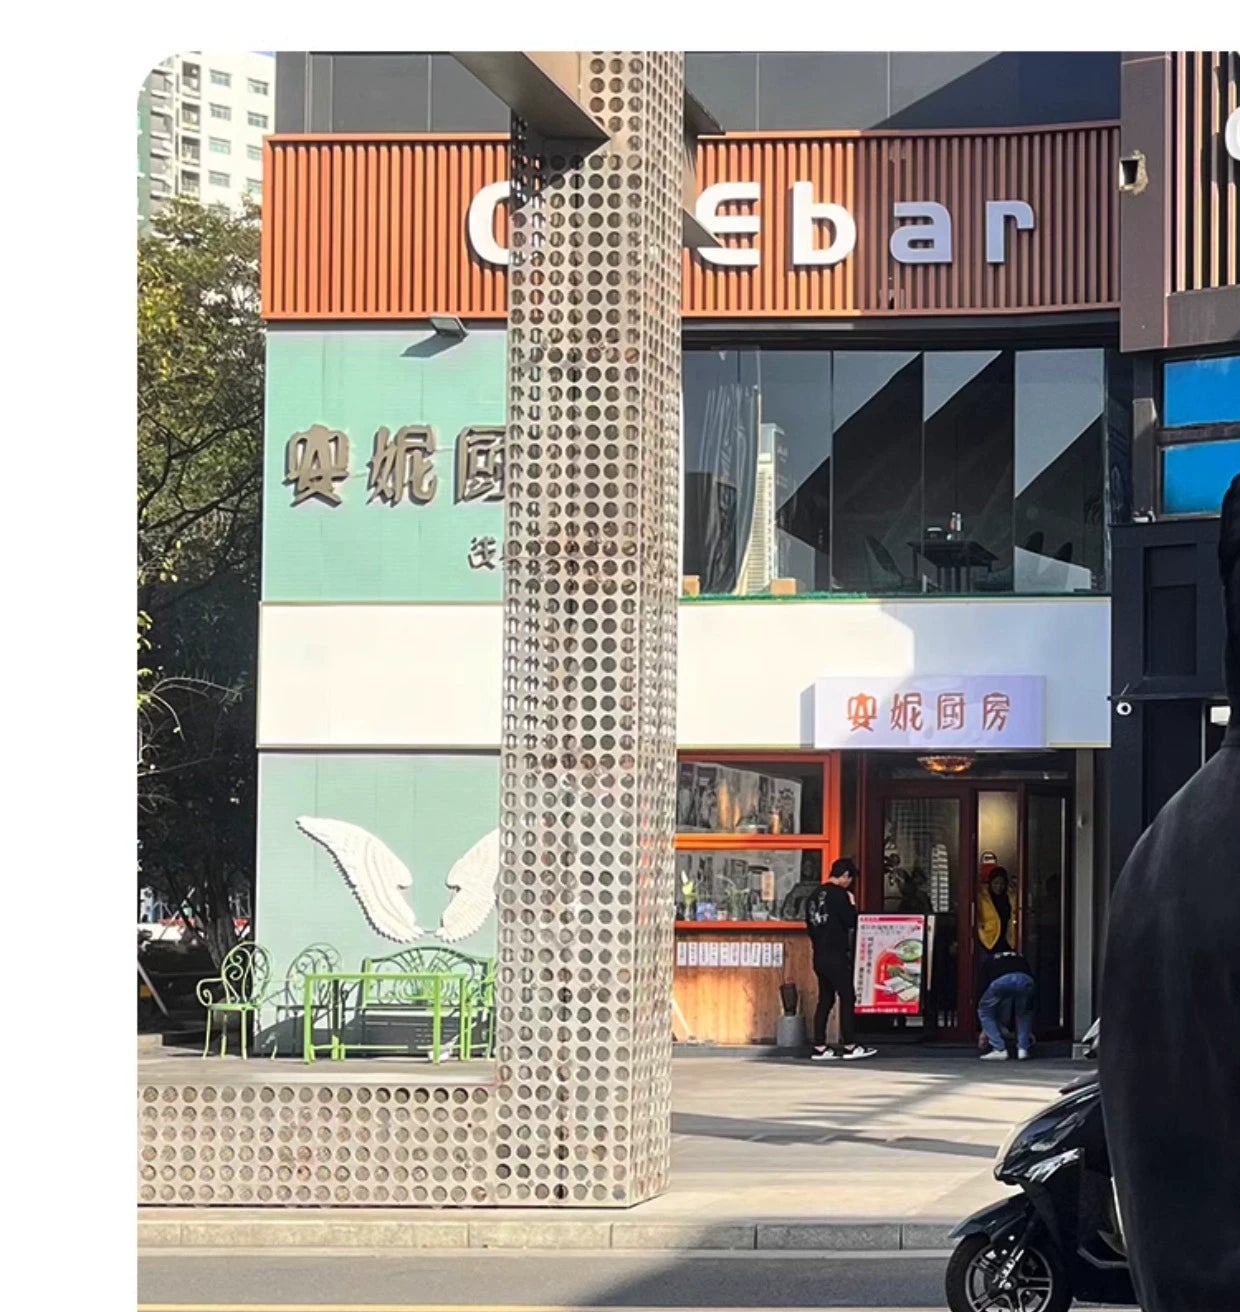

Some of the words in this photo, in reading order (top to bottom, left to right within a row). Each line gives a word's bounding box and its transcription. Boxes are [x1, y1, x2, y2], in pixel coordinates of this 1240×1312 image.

[468, 180, 1036, 266] OEbar
[846, 691, 1012, 733] 安妮厨房
